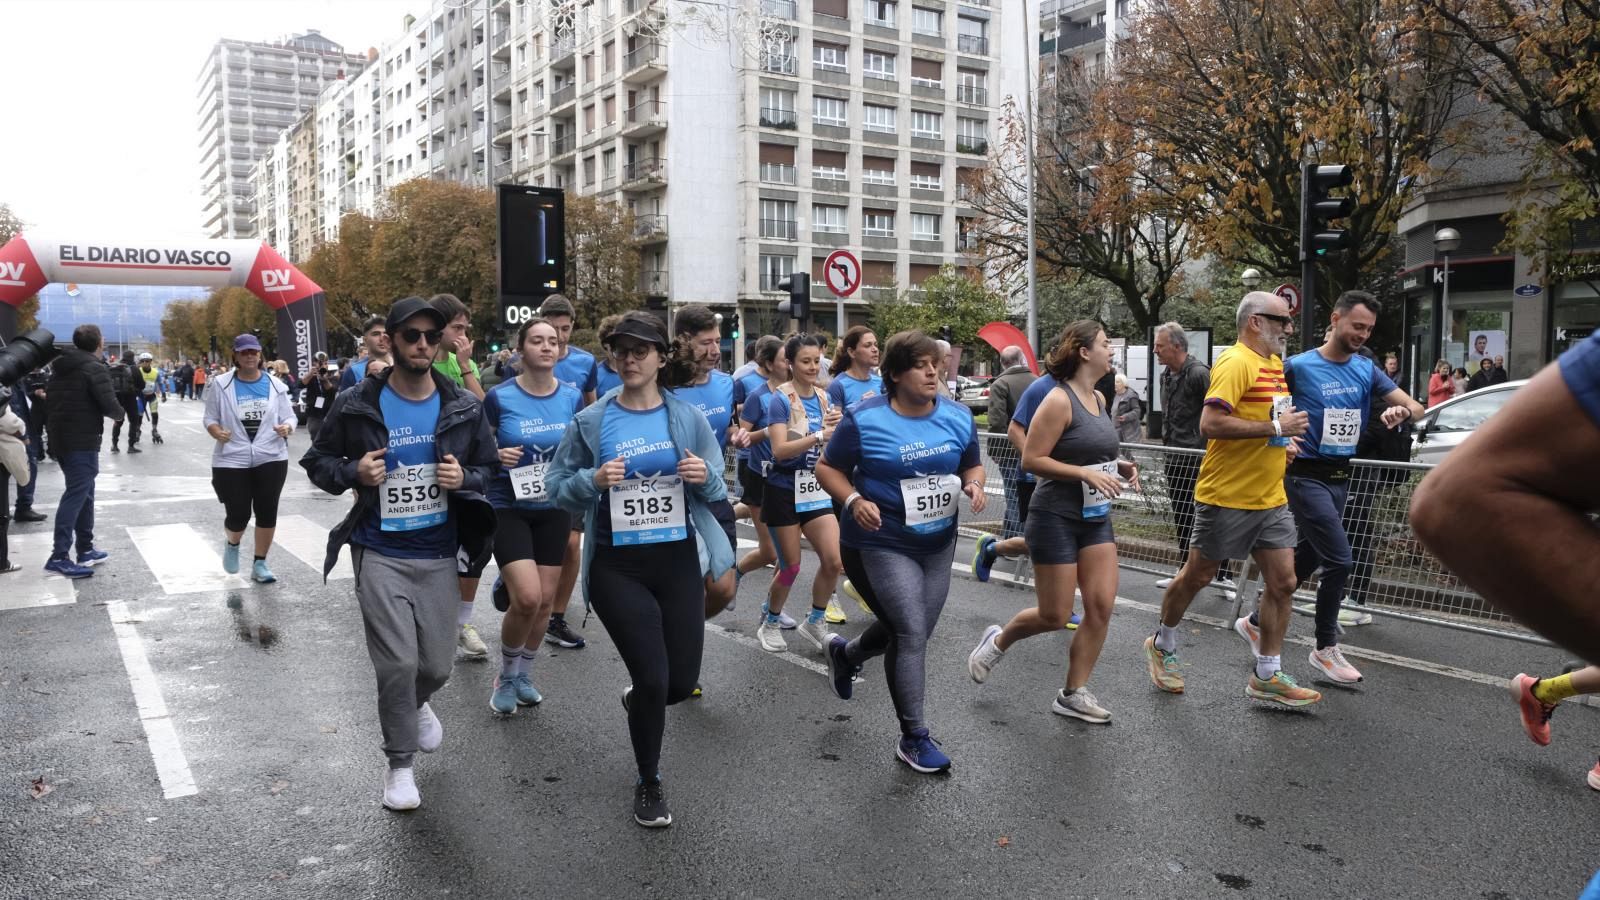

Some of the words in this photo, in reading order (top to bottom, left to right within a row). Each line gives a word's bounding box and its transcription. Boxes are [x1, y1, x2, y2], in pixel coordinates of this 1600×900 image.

[59, 245, 84, 261] EL
[88, 246, 161, 263] DIARIO
[164, 249, 231, 265] VASCO
[261, 269, 290, 286] DV
[507, 305, 542, 324] 09:
[296, 320, 307, 358] VASCO
[1321, 382, 1340, 390] SALTO
[1322, 386, 1358, 396] FOUNDATION
[520, 418, 543, 427] SALTO
[521, 422, 566, 434] FOUNDATION
[389, 426, 412, 437] ALTO
[1330, 423, 1358, 436] 5327
[389, 434, 436, 448] OUNDATIO
[615, 437, 646, 452] SALTO
[899, 441, 925, 453] SALTO
[901, 443, 951, 462] FOUNDATION
[387, 483, 441, 504] 5530
[521, 480, 546, 496] 55
[906, 483, 927, 491] SALTO
[388, 506, 415, 514] ANDRE
[417, 502, 441, 512] FELIPE
[623, 496, 673, 516] 5183
[917, 492, 952, 511] 5119
[629, 516, 669, 526] BEATRICE
[923, 510, 944, 519] MARTA
